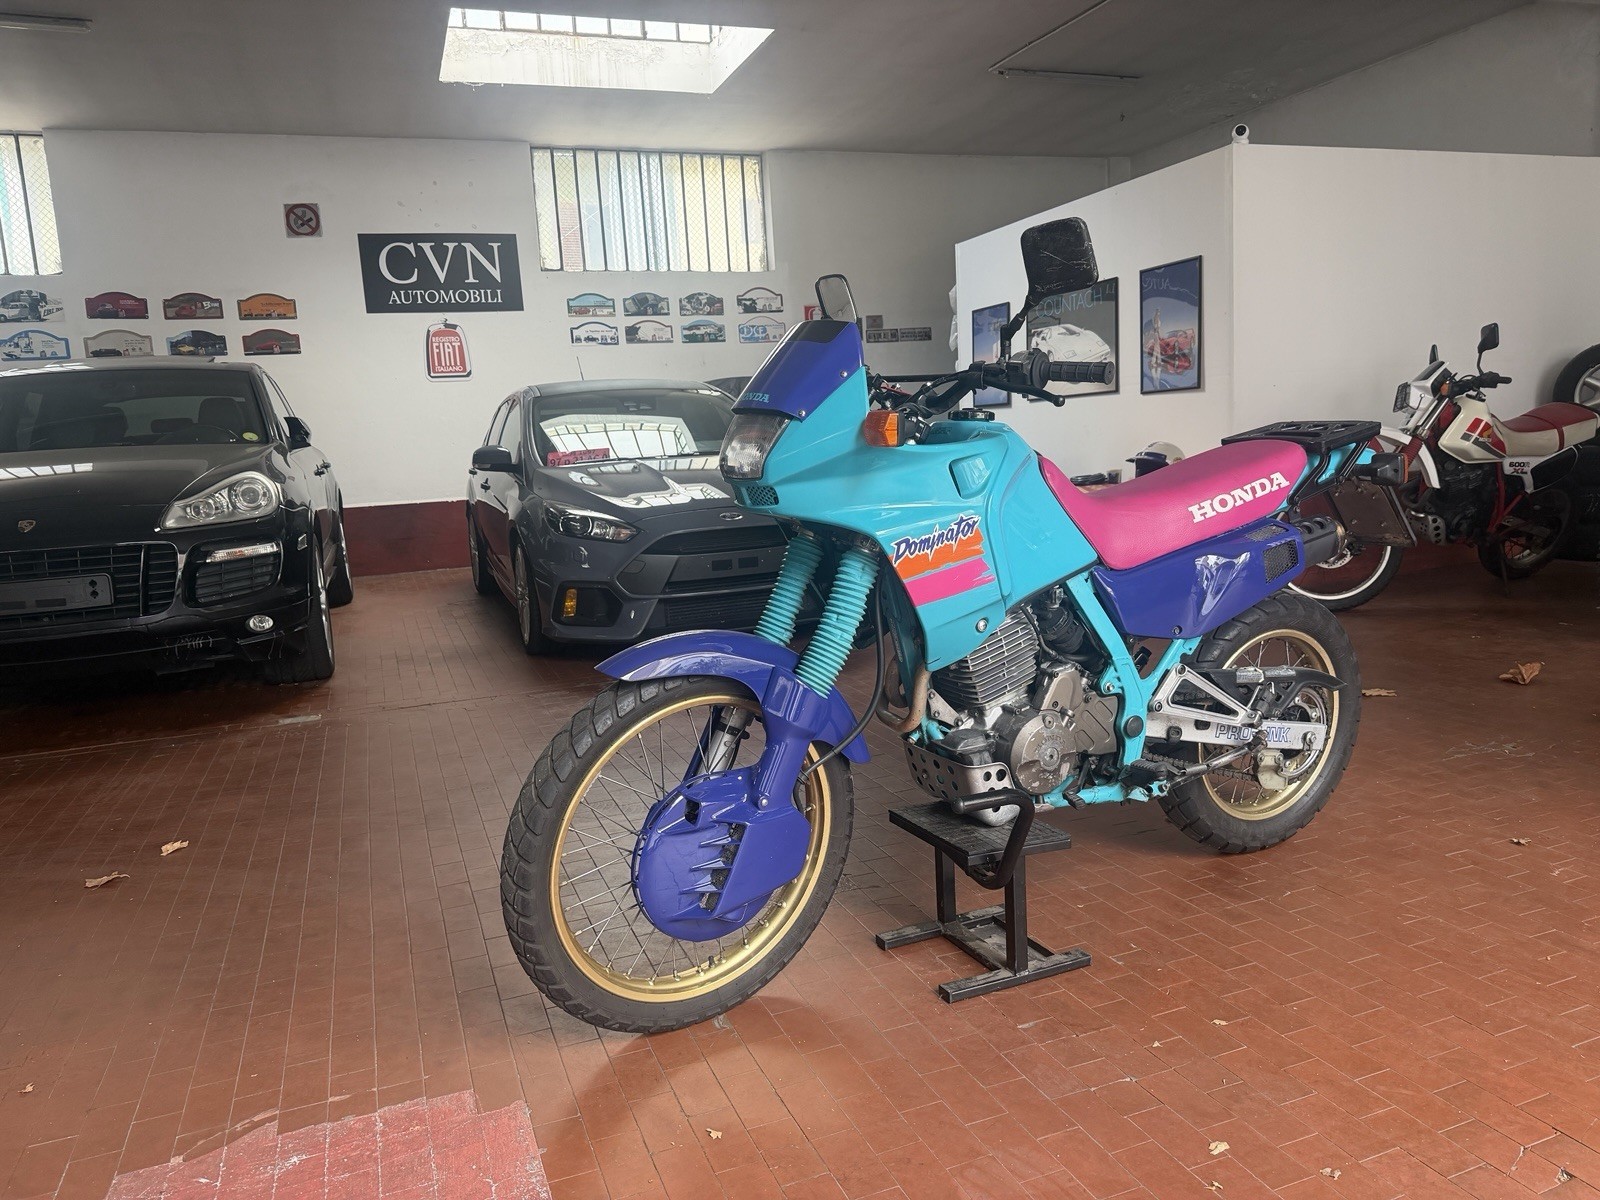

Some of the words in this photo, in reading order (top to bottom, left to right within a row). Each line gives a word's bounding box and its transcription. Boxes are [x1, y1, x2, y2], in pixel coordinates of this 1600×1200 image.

[378, 242, 502, 285] CVN
[388, 289, 503, 305] AUTOMOBILI
[1035, 285, 1103, 319] COUNTACH
[432, 342, 461, 367] FIAT
[741, 392, 770, 404] ONDA
[1510, 467, 1528, 475] XL
[1187, 471, 1290, 523] HONDA
[892, 514, 981, 566] Dominator
